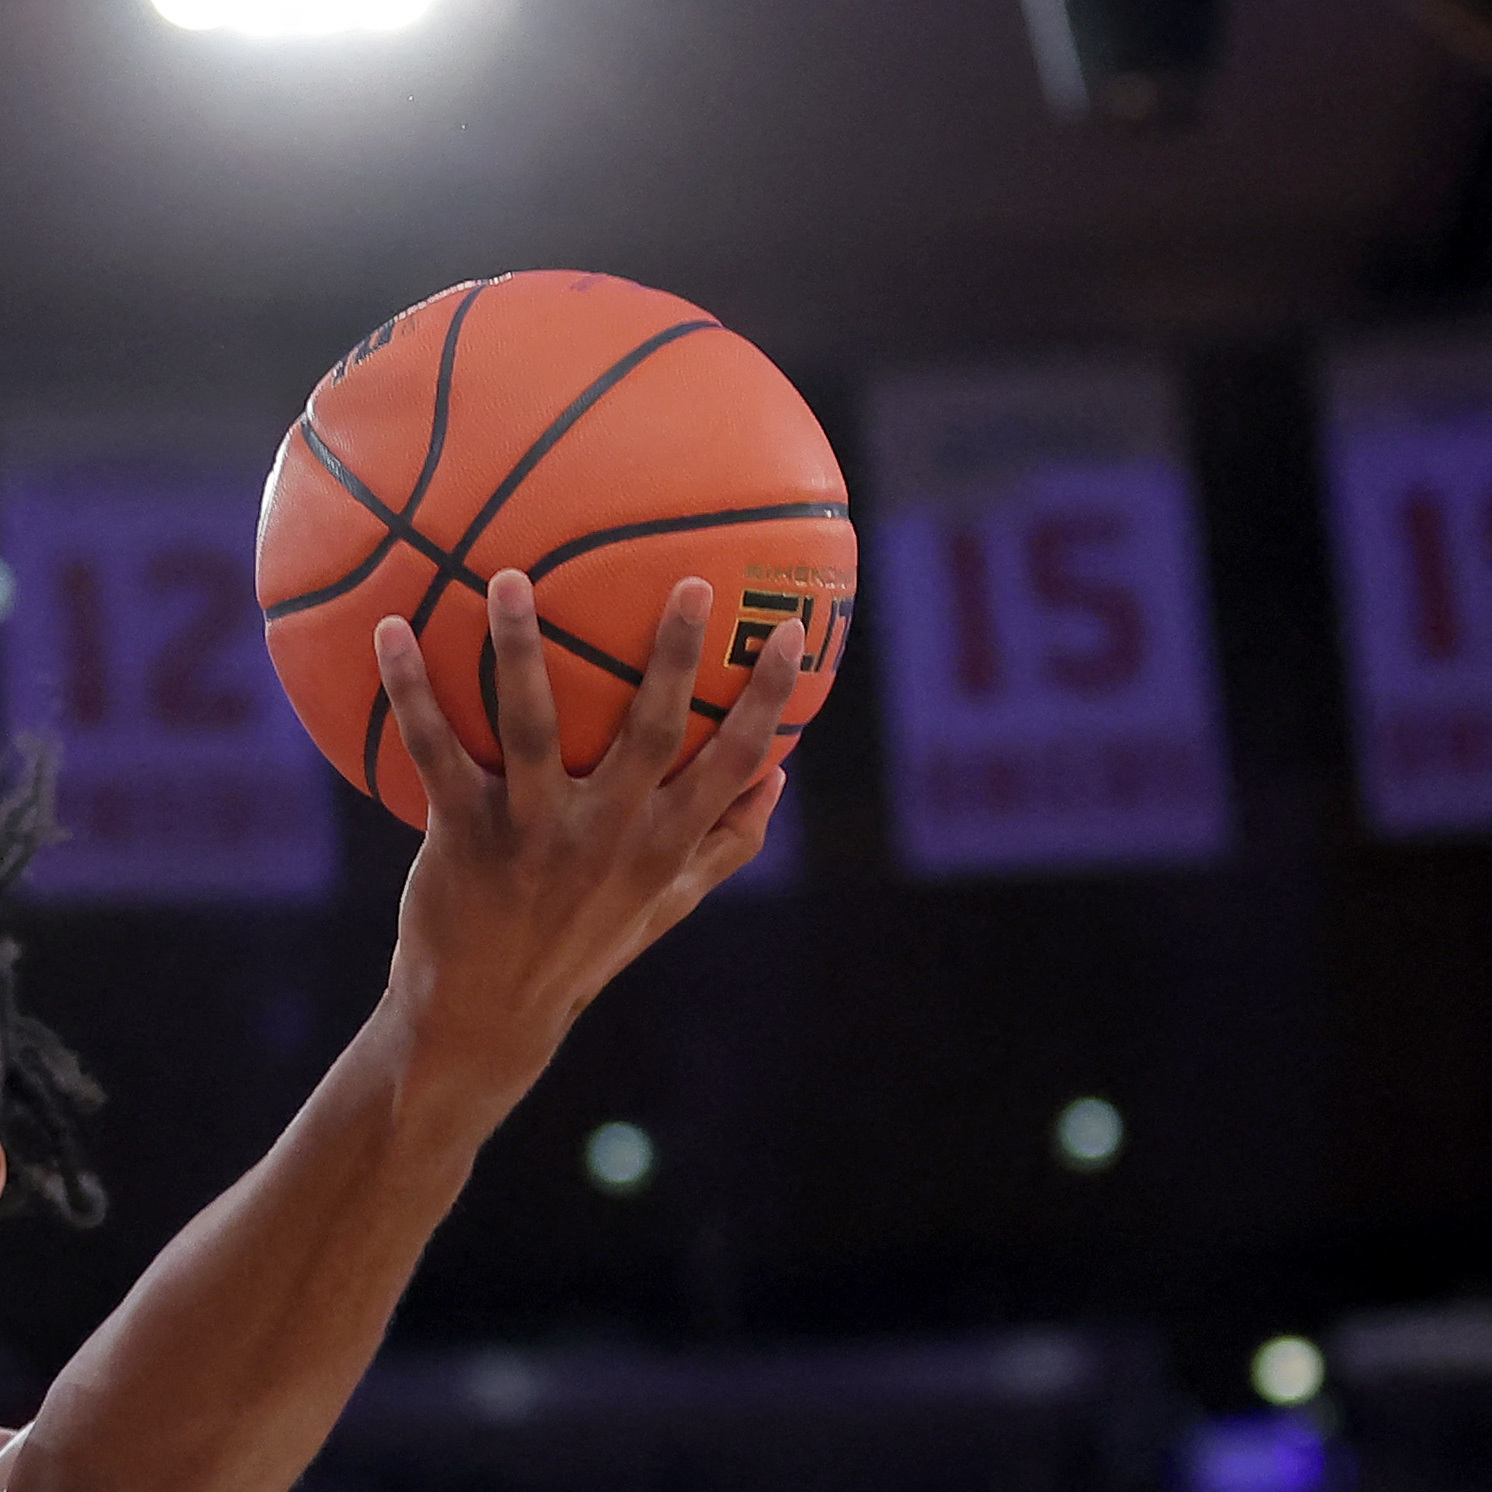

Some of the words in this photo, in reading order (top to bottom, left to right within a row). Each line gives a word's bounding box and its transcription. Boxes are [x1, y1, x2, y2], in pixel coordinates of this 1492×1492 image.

[58, 545, 262, 734] 12
[942, 511, 1146, 700] 15
[1401, 481, 1492, 663] 1
